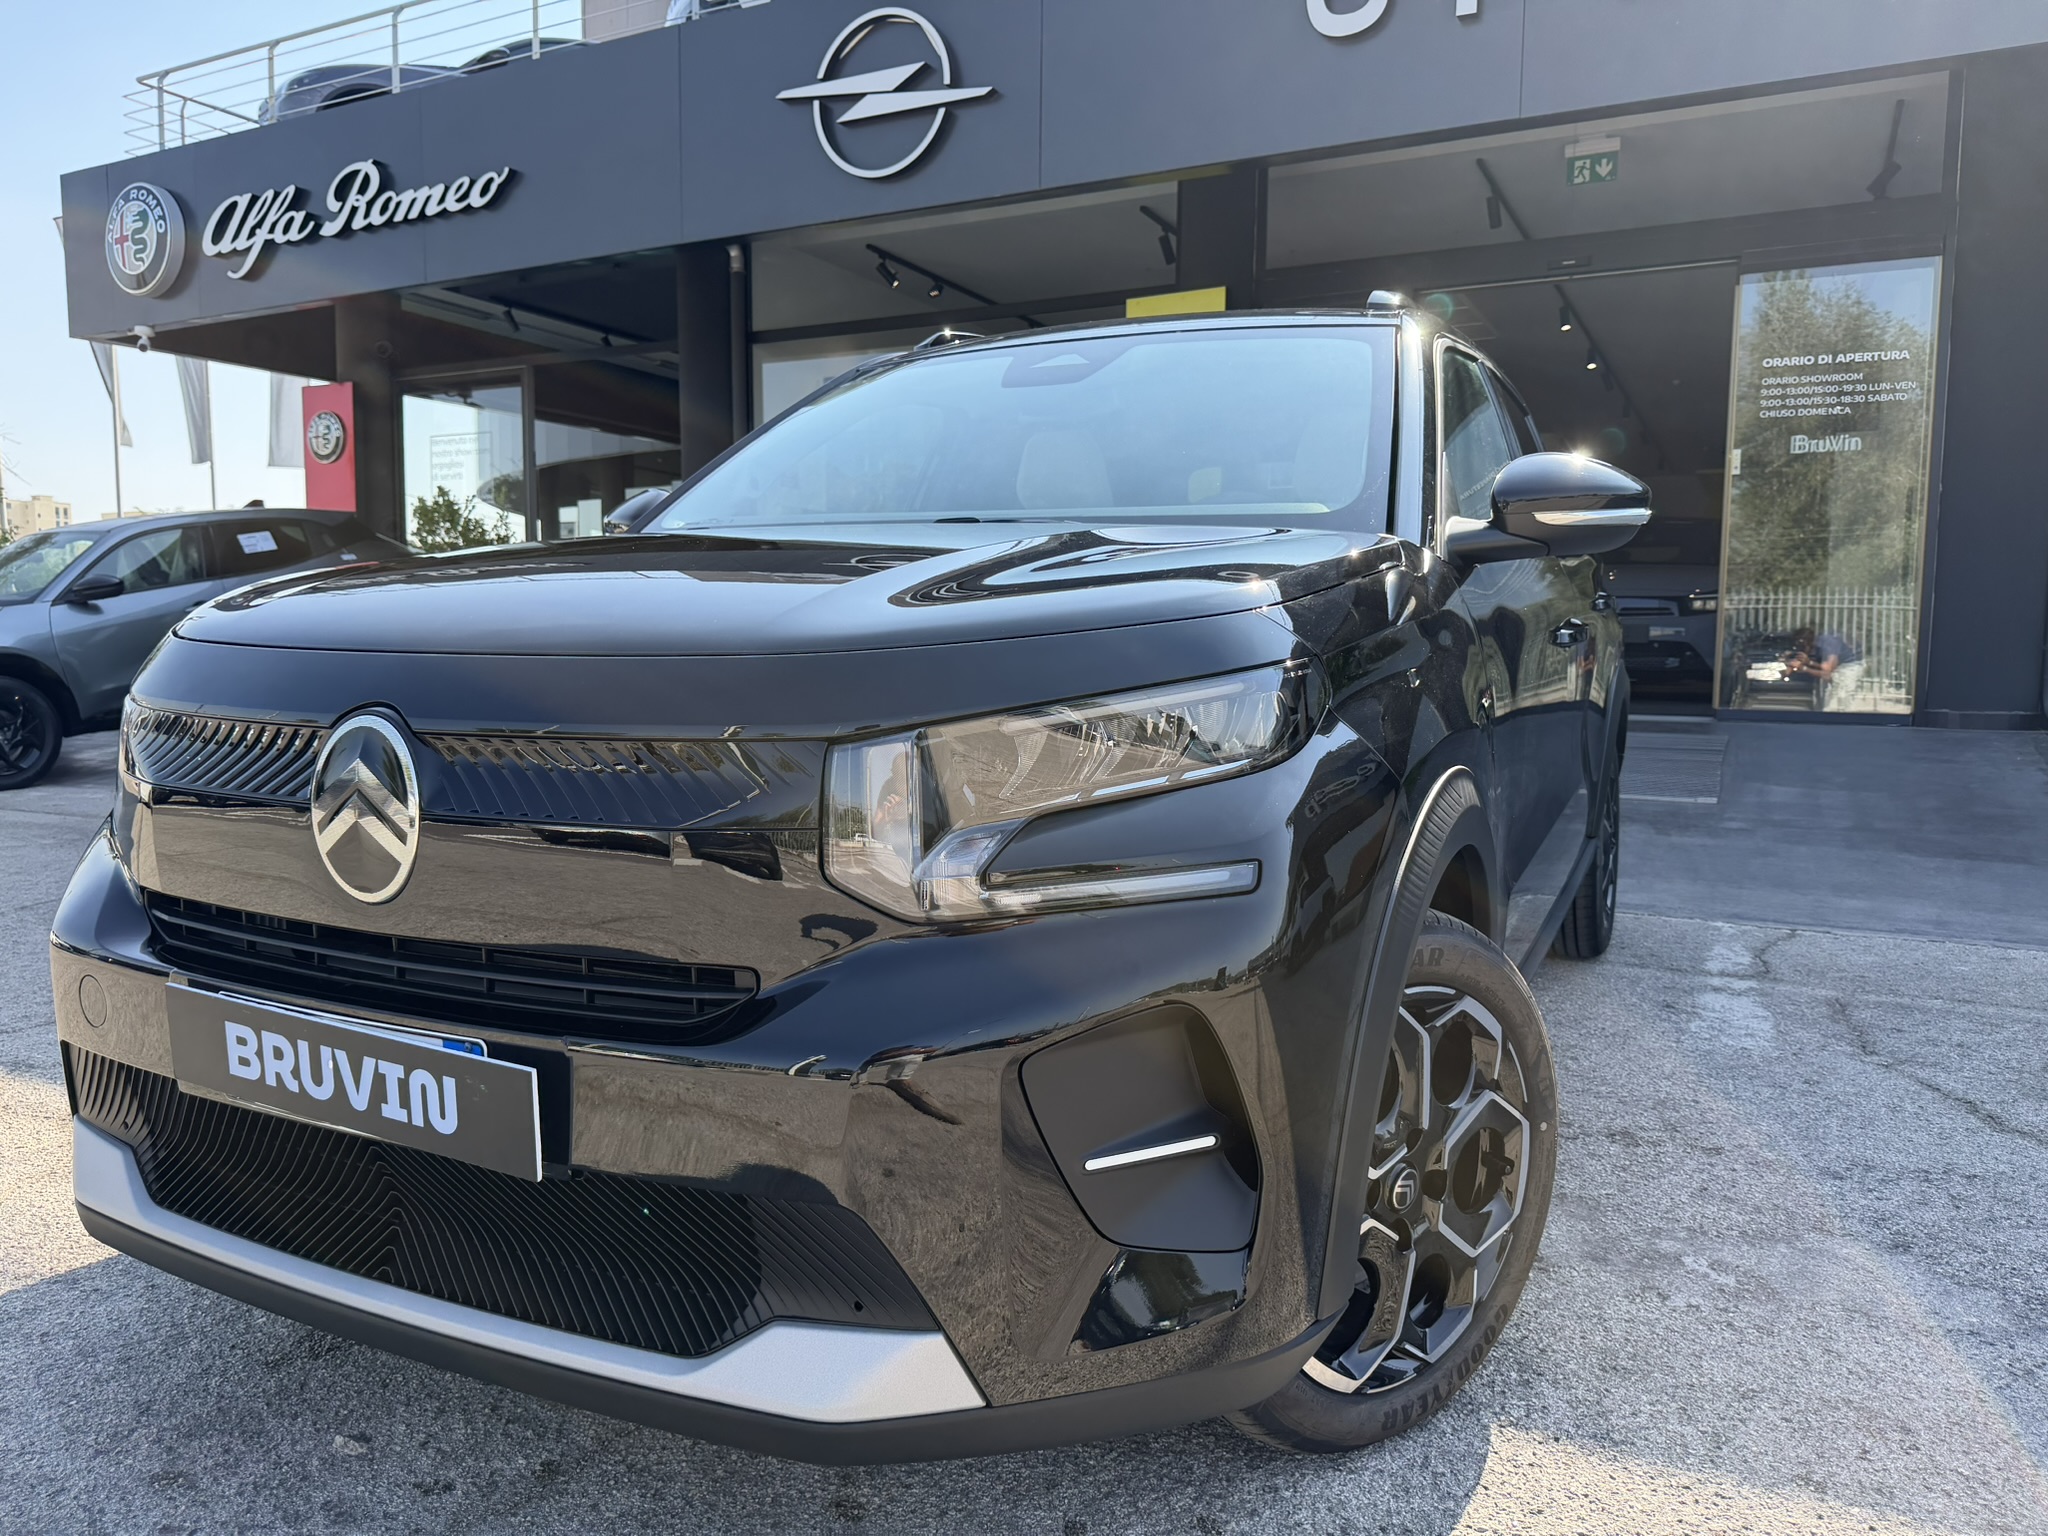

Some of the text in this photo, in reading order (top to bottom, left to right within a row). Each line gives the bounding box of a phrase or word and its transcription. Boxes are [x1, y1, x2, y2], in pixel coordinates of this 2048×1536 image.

[130, 189, 166, 233] ROMEO
[202, 159, 509, 279] Alfa Romeo
[1762, 350, 1911, 368] ORARIO DI APERTURA
[1761, 373, 1863, 386] ORARIO SHOWROOM
[1869, 381, 1917, 391] LUN-VEN
[1867, 393, 1908, 402] SABATO
[1759, 410, 1796, 418] CHIUSO
[224, 1020, 459, 1135] BRUVIN
[1382, 1303, 1508, 1431] GOODYEAR
